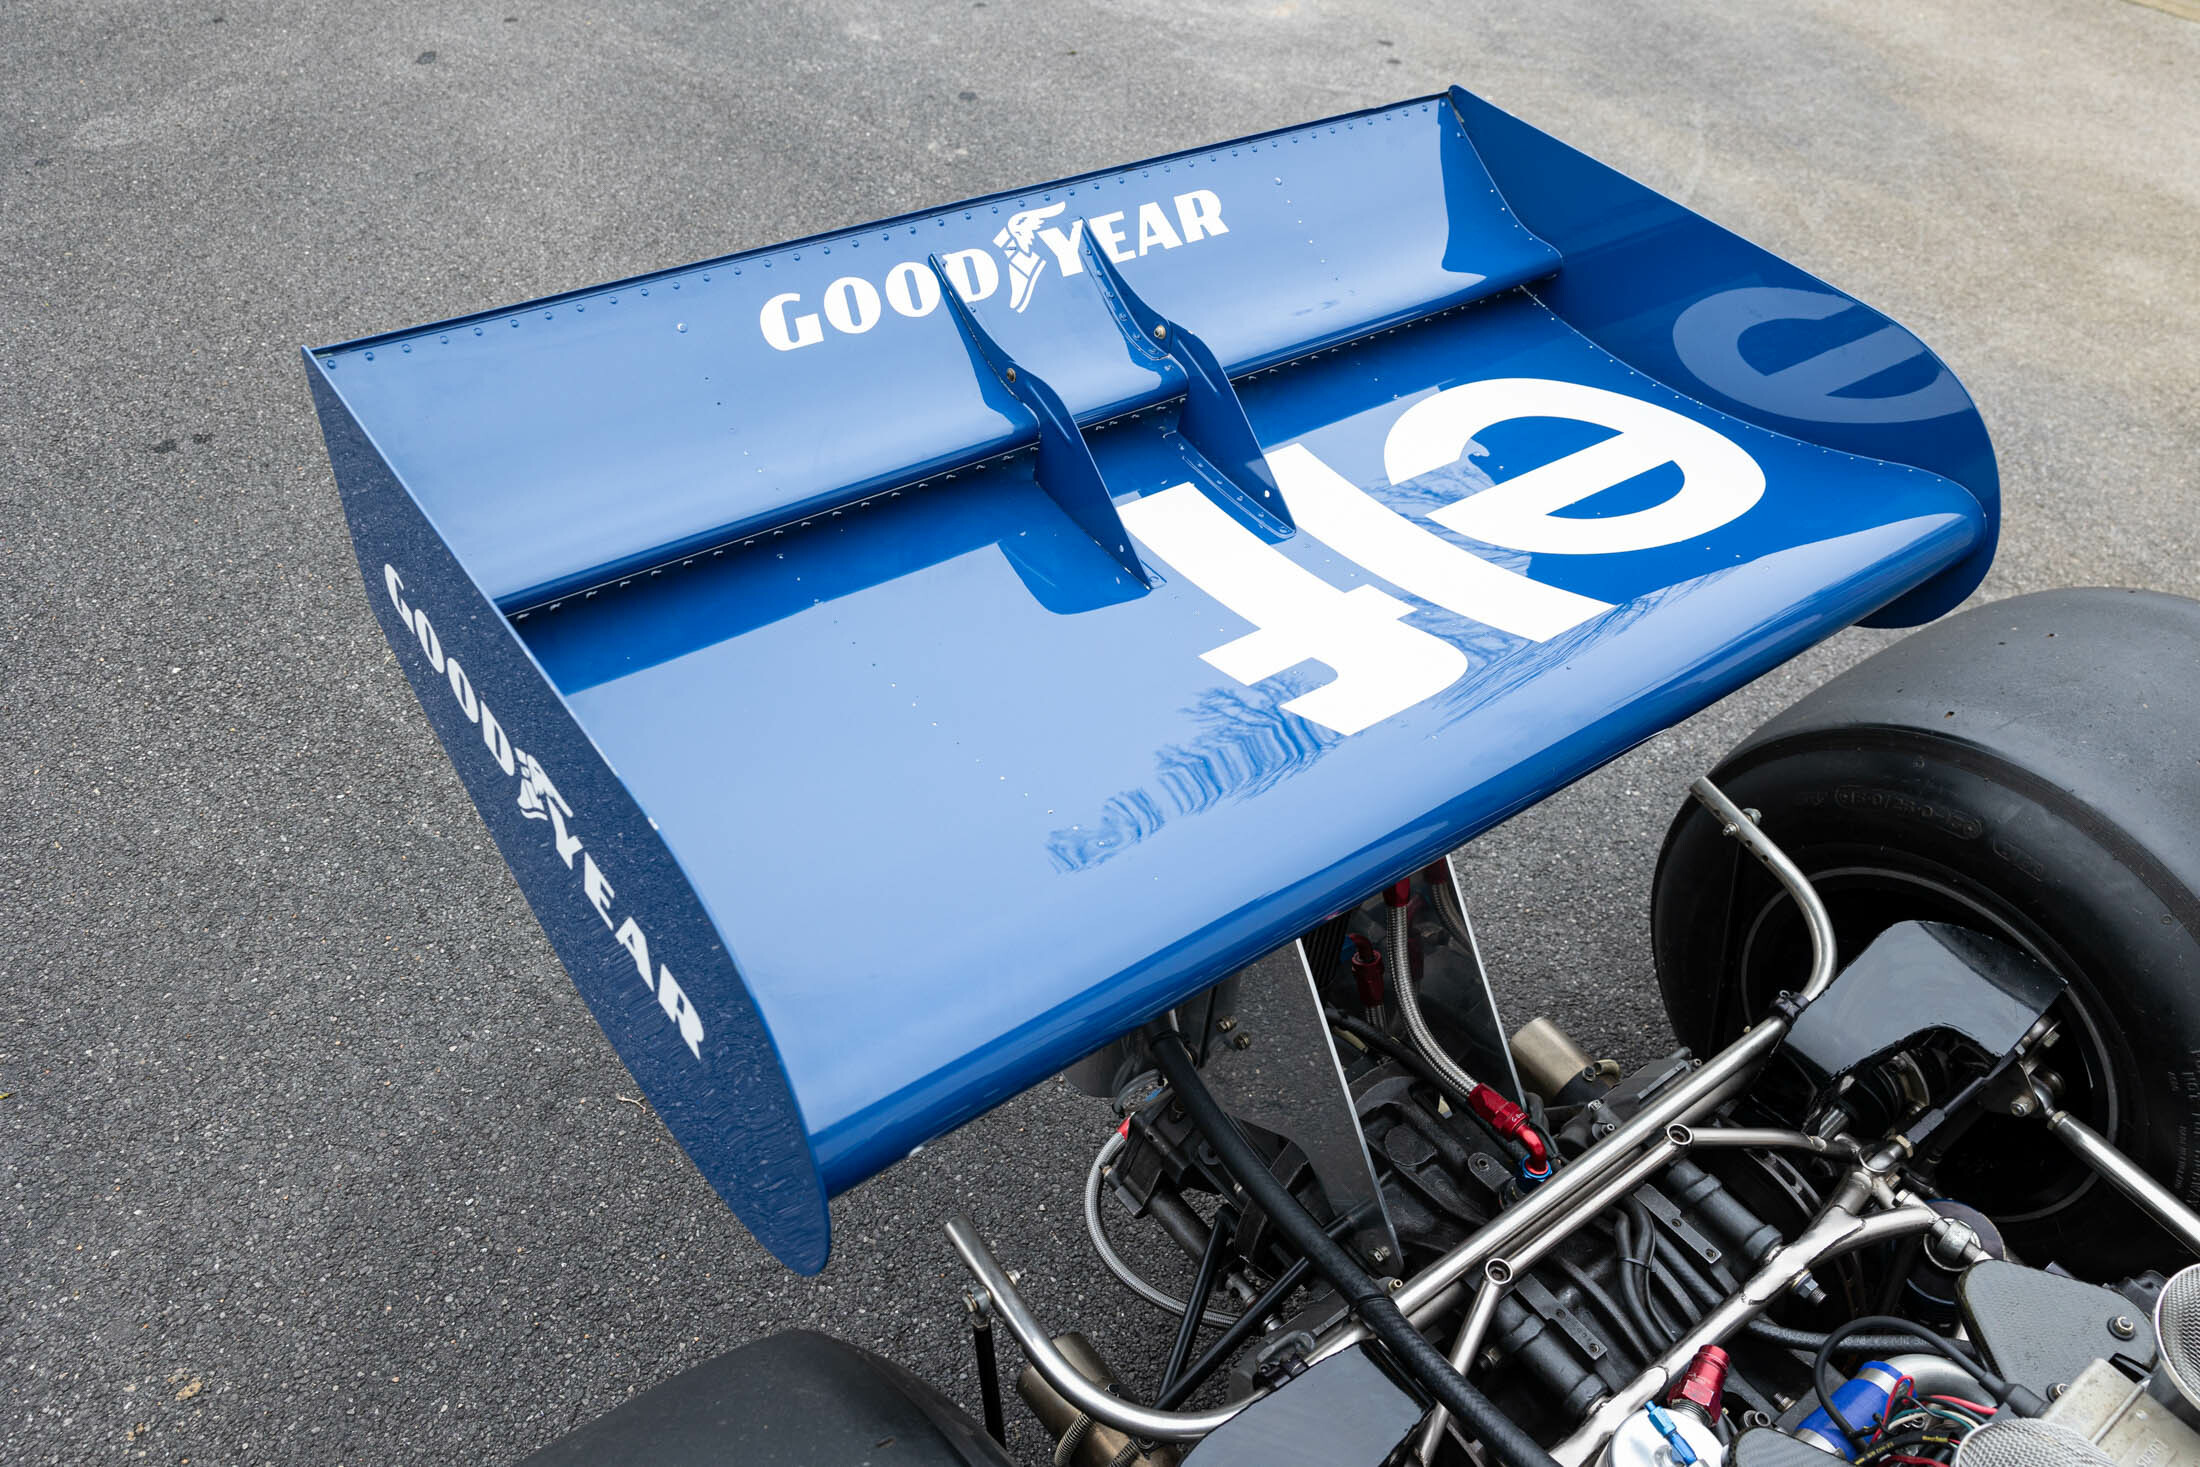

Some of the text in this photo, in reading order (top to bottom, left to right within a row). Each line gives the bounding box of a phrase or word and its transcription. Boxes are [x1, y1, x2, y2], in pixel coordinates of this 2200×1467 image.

[759, 189, 1230, 351] GOODYEAR
[1116, 378, 1766, 736] elf
[384, 563, 705, 1060] GOODYEAR
